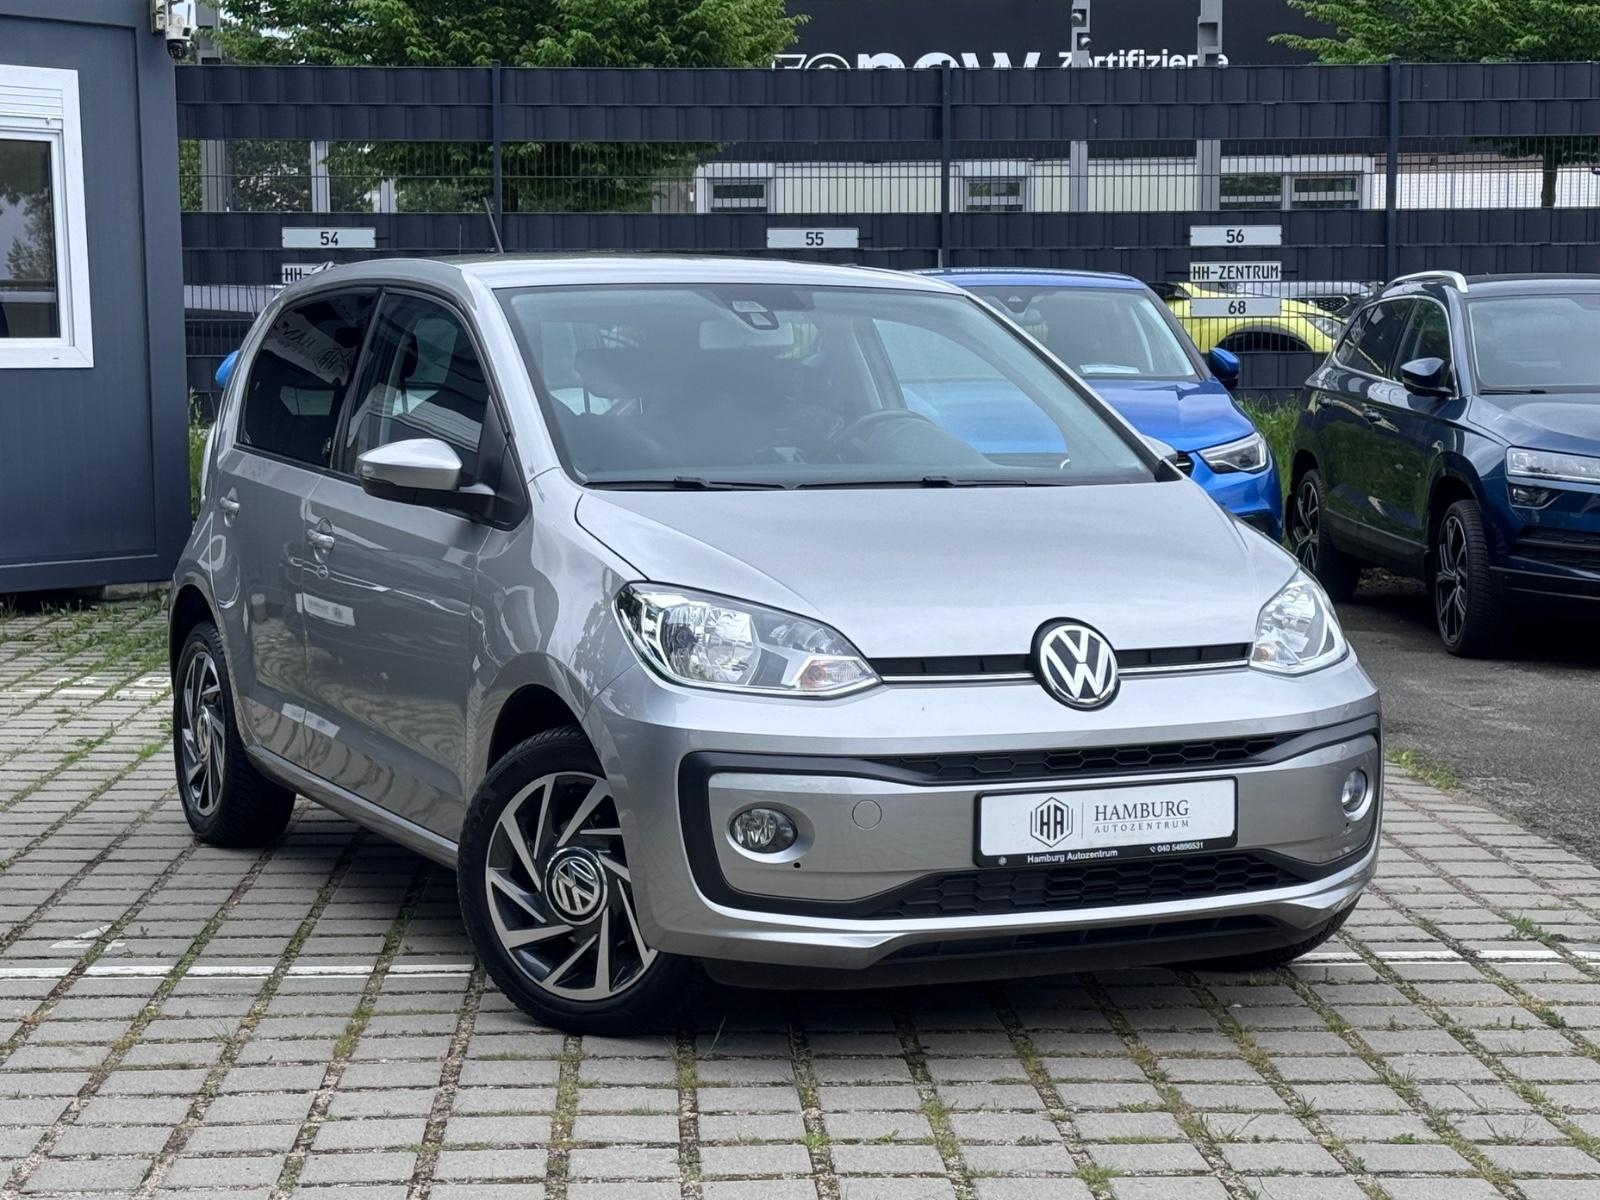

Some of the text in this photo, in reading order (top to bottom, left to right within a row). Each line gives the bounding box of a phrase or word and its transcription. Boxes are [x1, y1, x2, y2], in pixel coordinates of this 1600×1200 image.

[320, 231, 339, 246] 54
[805, 231, 824, 246] 55
[1226, 229, 1245, 244] 56
[1192, 264, 1280, 280] HH-ZENTRUM
[1228, 300, 1246, 315] 68
[1093, 800, 1189, 822] HAMBURG
[1039, 804, 1065, 841] HA
[1093, 820, 1189, 834] AUTOZENTRUM
[1157, 843, 1171, 853] 040
[1027, 849, 1118, 864] Hamburg Autozentrum
